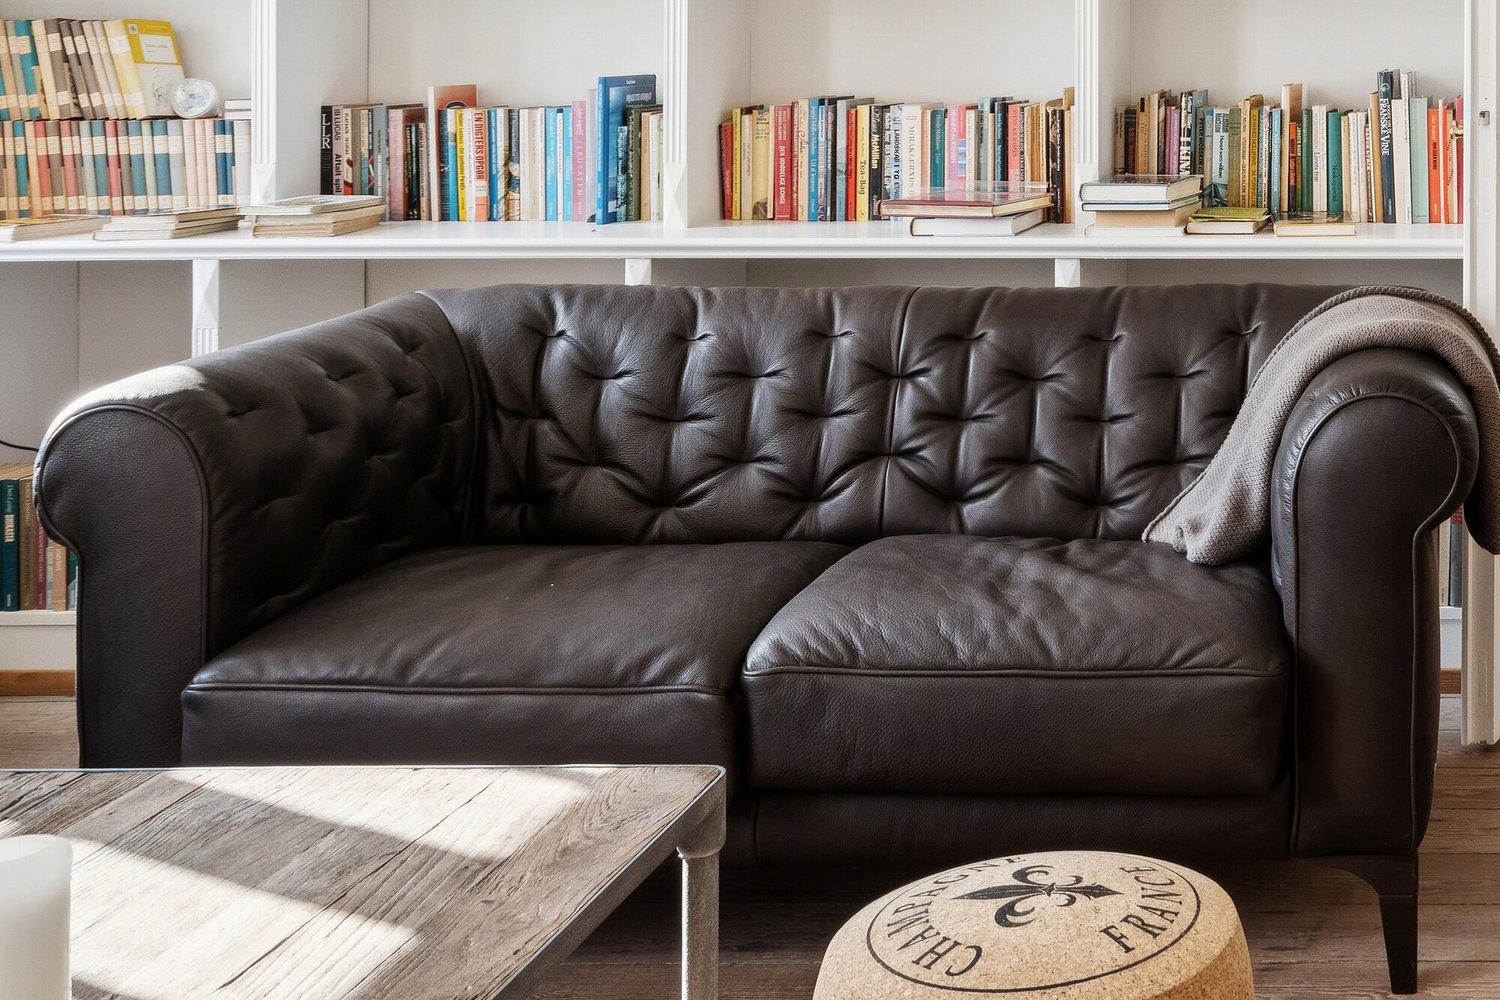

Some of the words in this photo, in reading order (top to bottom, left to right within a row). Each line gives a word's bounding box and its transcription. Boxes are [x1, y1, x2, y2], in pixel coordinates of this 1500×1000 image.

[475, 113, 483, 121] EN
[1381, 98, 1389, 134] FRANSKE
[474, 123, 483, 154] DIGTERS
[871, 135, 879, 169] McMillan
[475, 156, 484, 180] OPGØR
[858, 160, 867, 194] Tea-Bag
[333, 179, 342, 193] spil
[887, 856, 1026, 977] CHAMPAGNE
[1099, 865, 1183, 954] FRANCE
